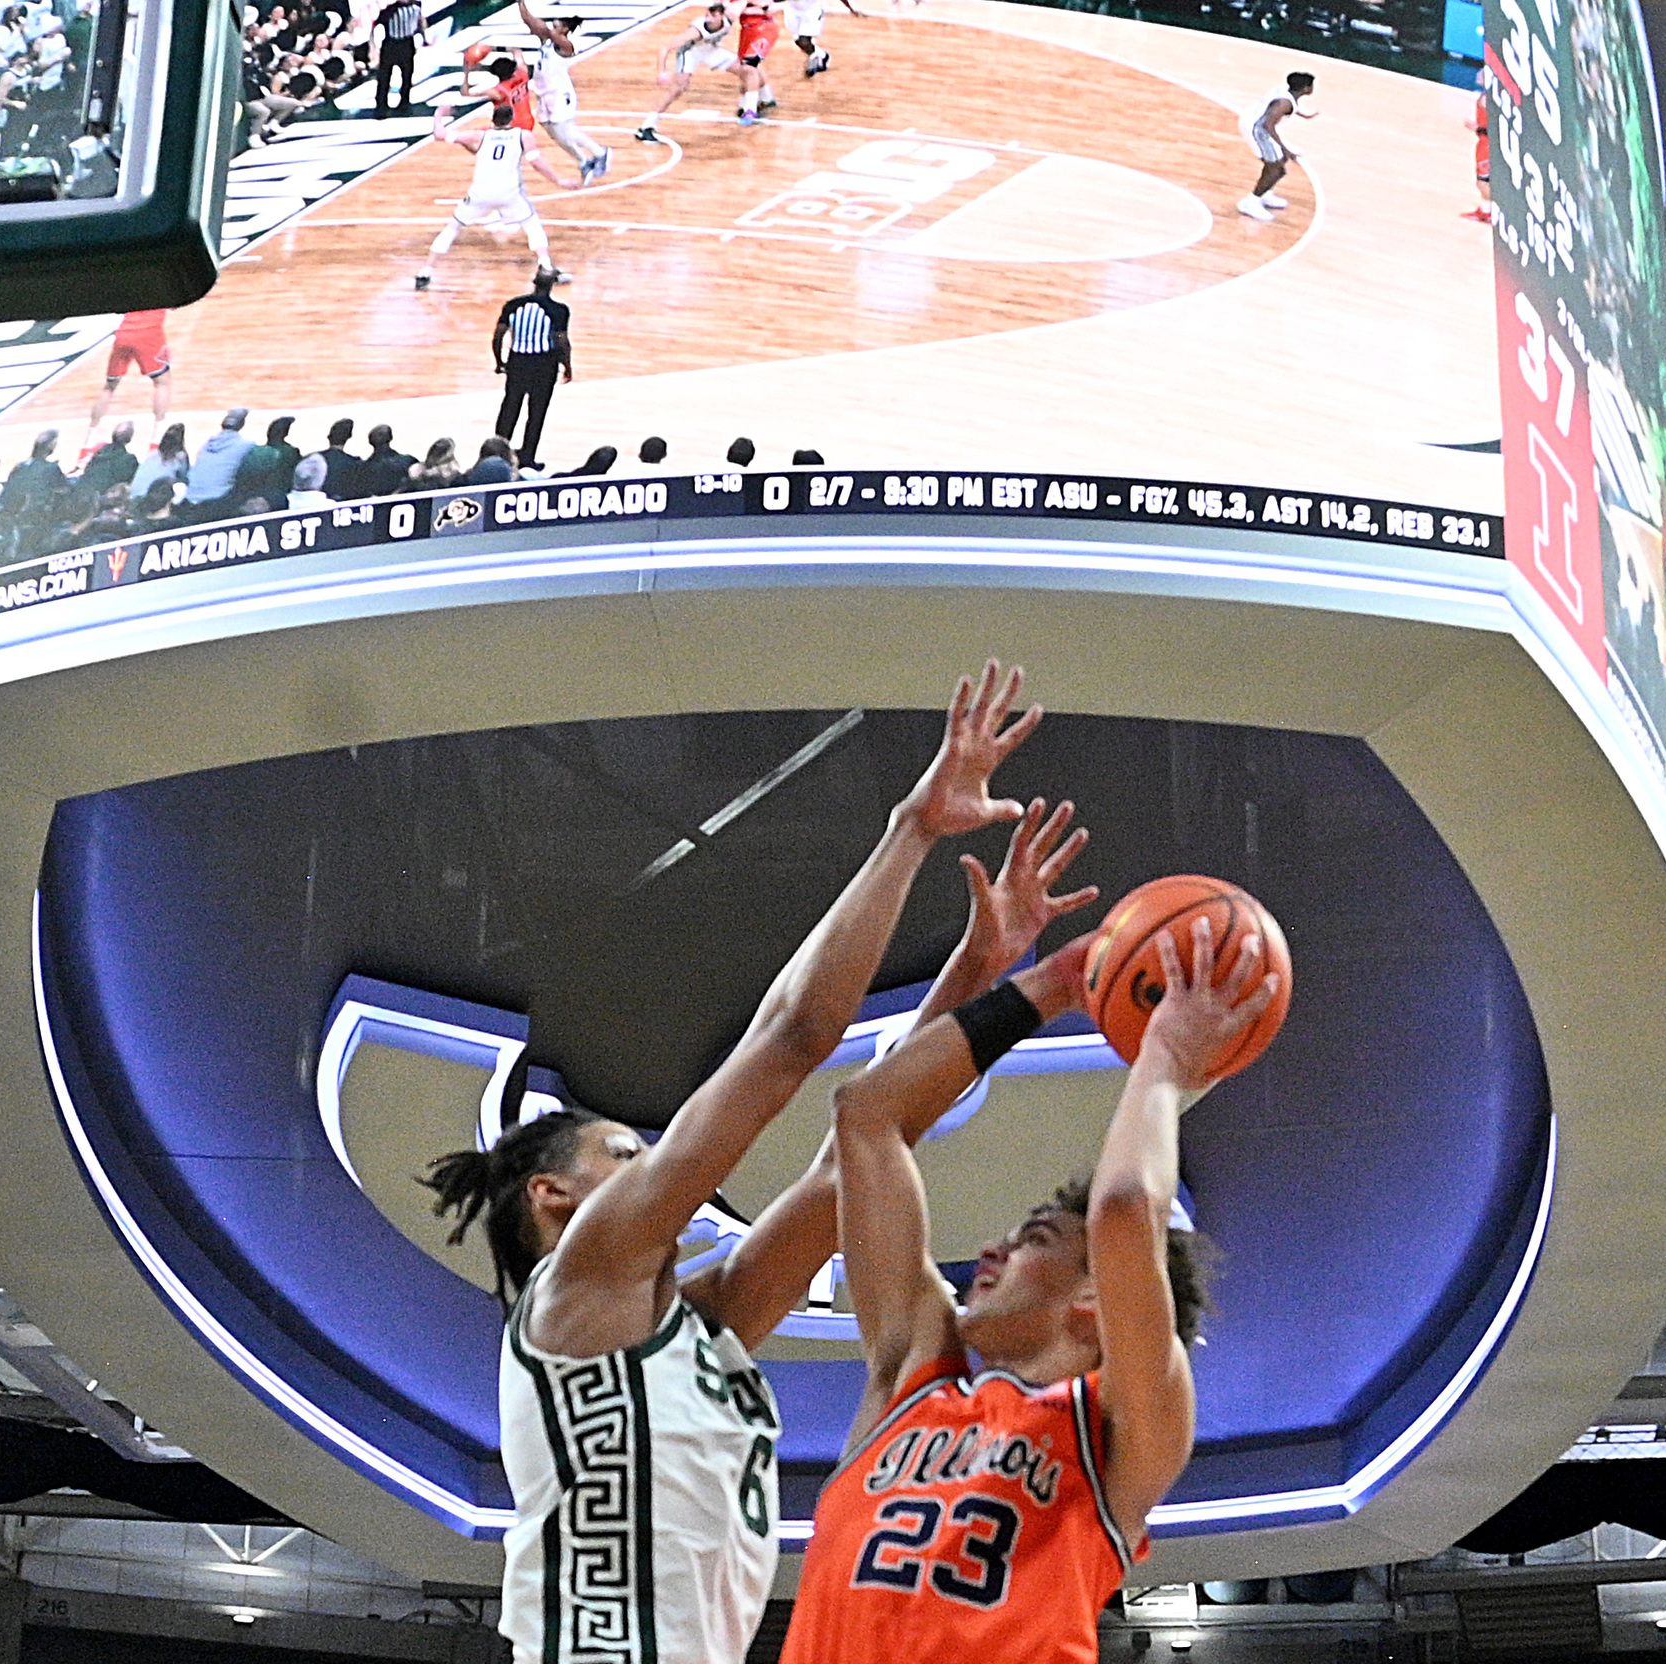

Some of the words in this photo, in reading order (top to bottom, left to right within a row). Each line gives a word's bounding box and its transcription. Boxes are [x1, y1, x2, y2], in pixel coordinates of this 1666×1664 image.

[1514, 291, 1575, 437] 37
[494, 483, 667, 524] COLORADO
[810, 476, 854, 507] 2/7
[947, 476, 983, 507] PM
[991, 477, 1038, 508] EST
[1044, 481, 1098, 510] ASU
[1130, 485, 1179, 515] FG%
[1188, 489, 1255, 523] 45.3,
[1262, 495, 1313, 526] AST
[140, 526, 270, 574] ARIZONA
[280, 516, 322, 550] ST
[739, 1434, 773, 1539] 6
[849, 1491, 1024, 1611] 23
